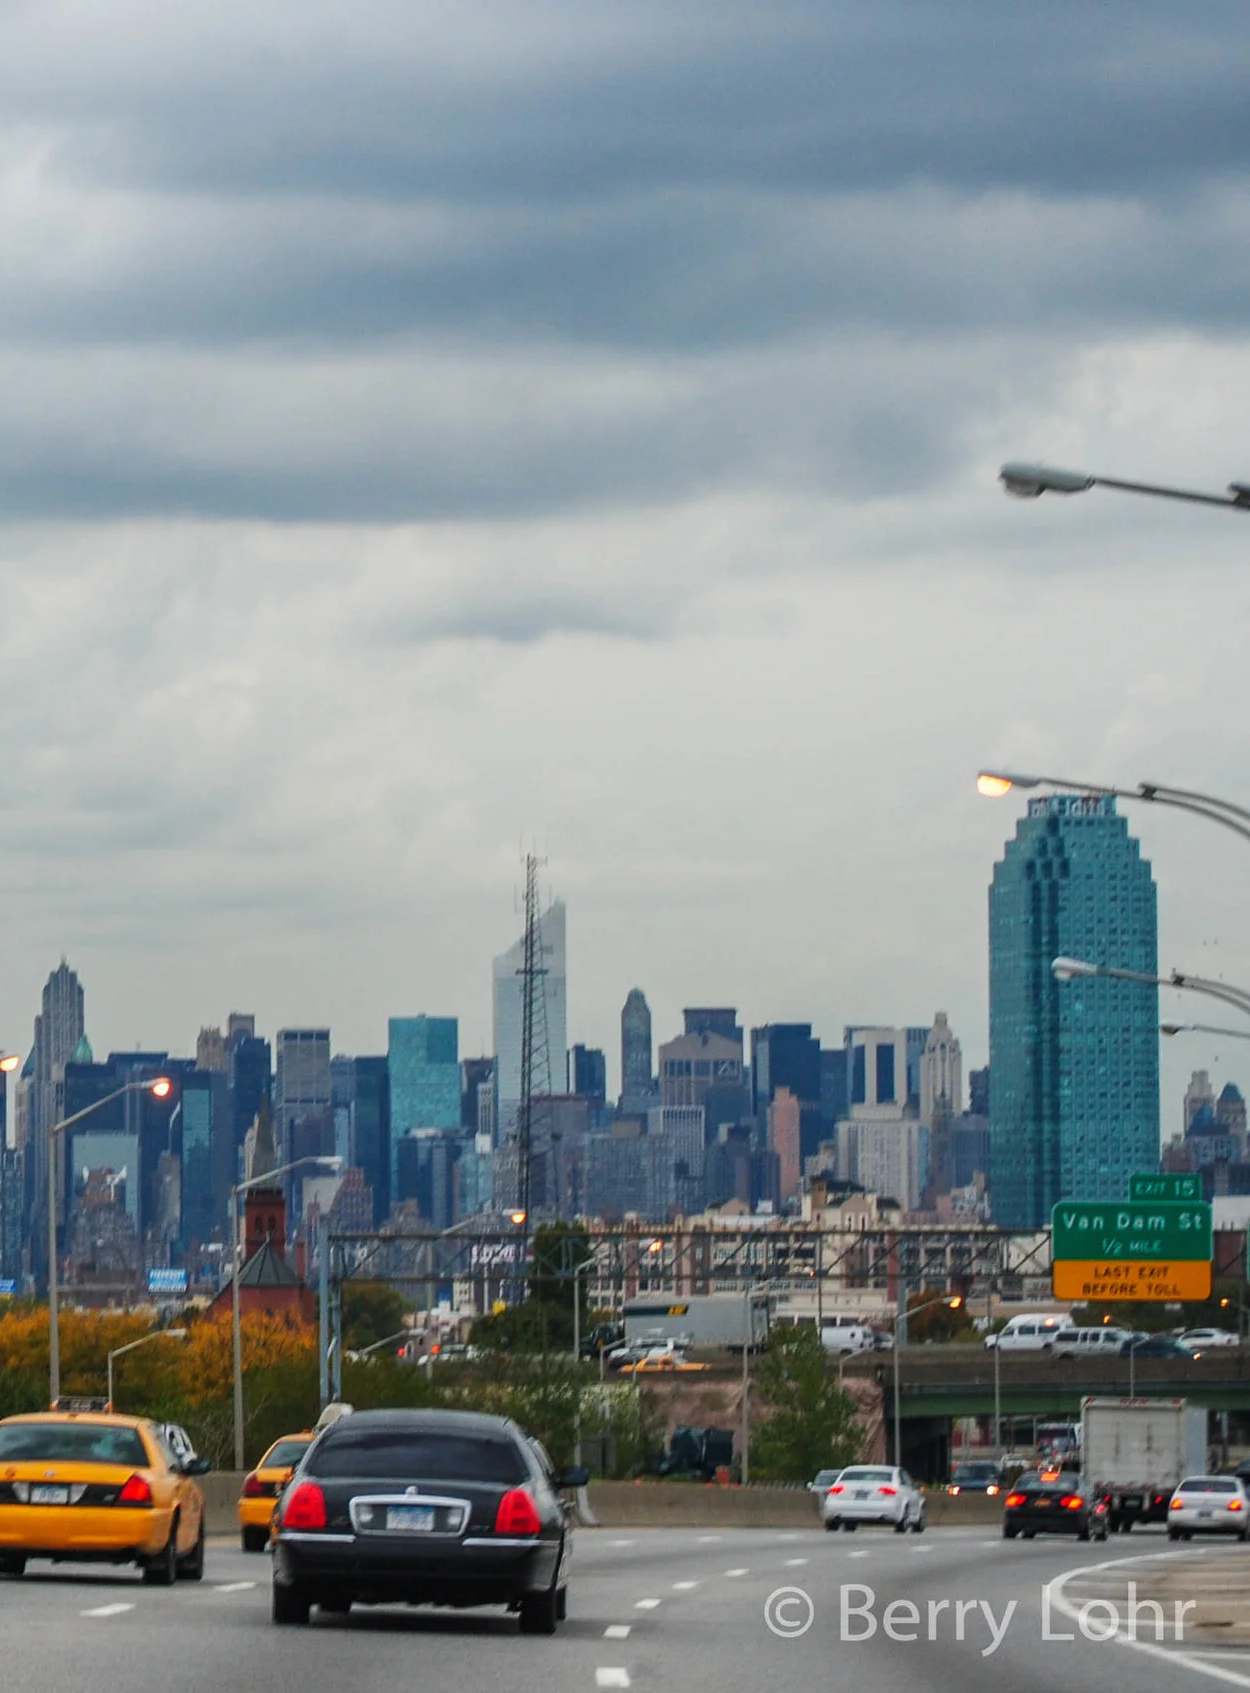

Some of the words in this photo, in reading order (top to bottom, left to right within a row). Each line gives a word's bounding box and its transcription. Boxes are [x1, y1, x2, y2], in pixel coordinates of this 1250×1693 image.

[1135, 1182, 1166, 1195] EXIT
[1174, 1180, 1194, 1196] 15
[1062, 1212, 1104, 1230] Van
[1117, 1212, 1166, 1230] Dam
[1179, 1212, 1202, 1230] St
[1129, 1240, 1162, 1254] MILE
[1094, 1266, 1130, 1279] LAST
[1138, 1266, 1170, 1279] EXIT
[1082, 1283, 1138, 1296] BEFORE
[1146, 1283, 1181, 1296] TOLL
